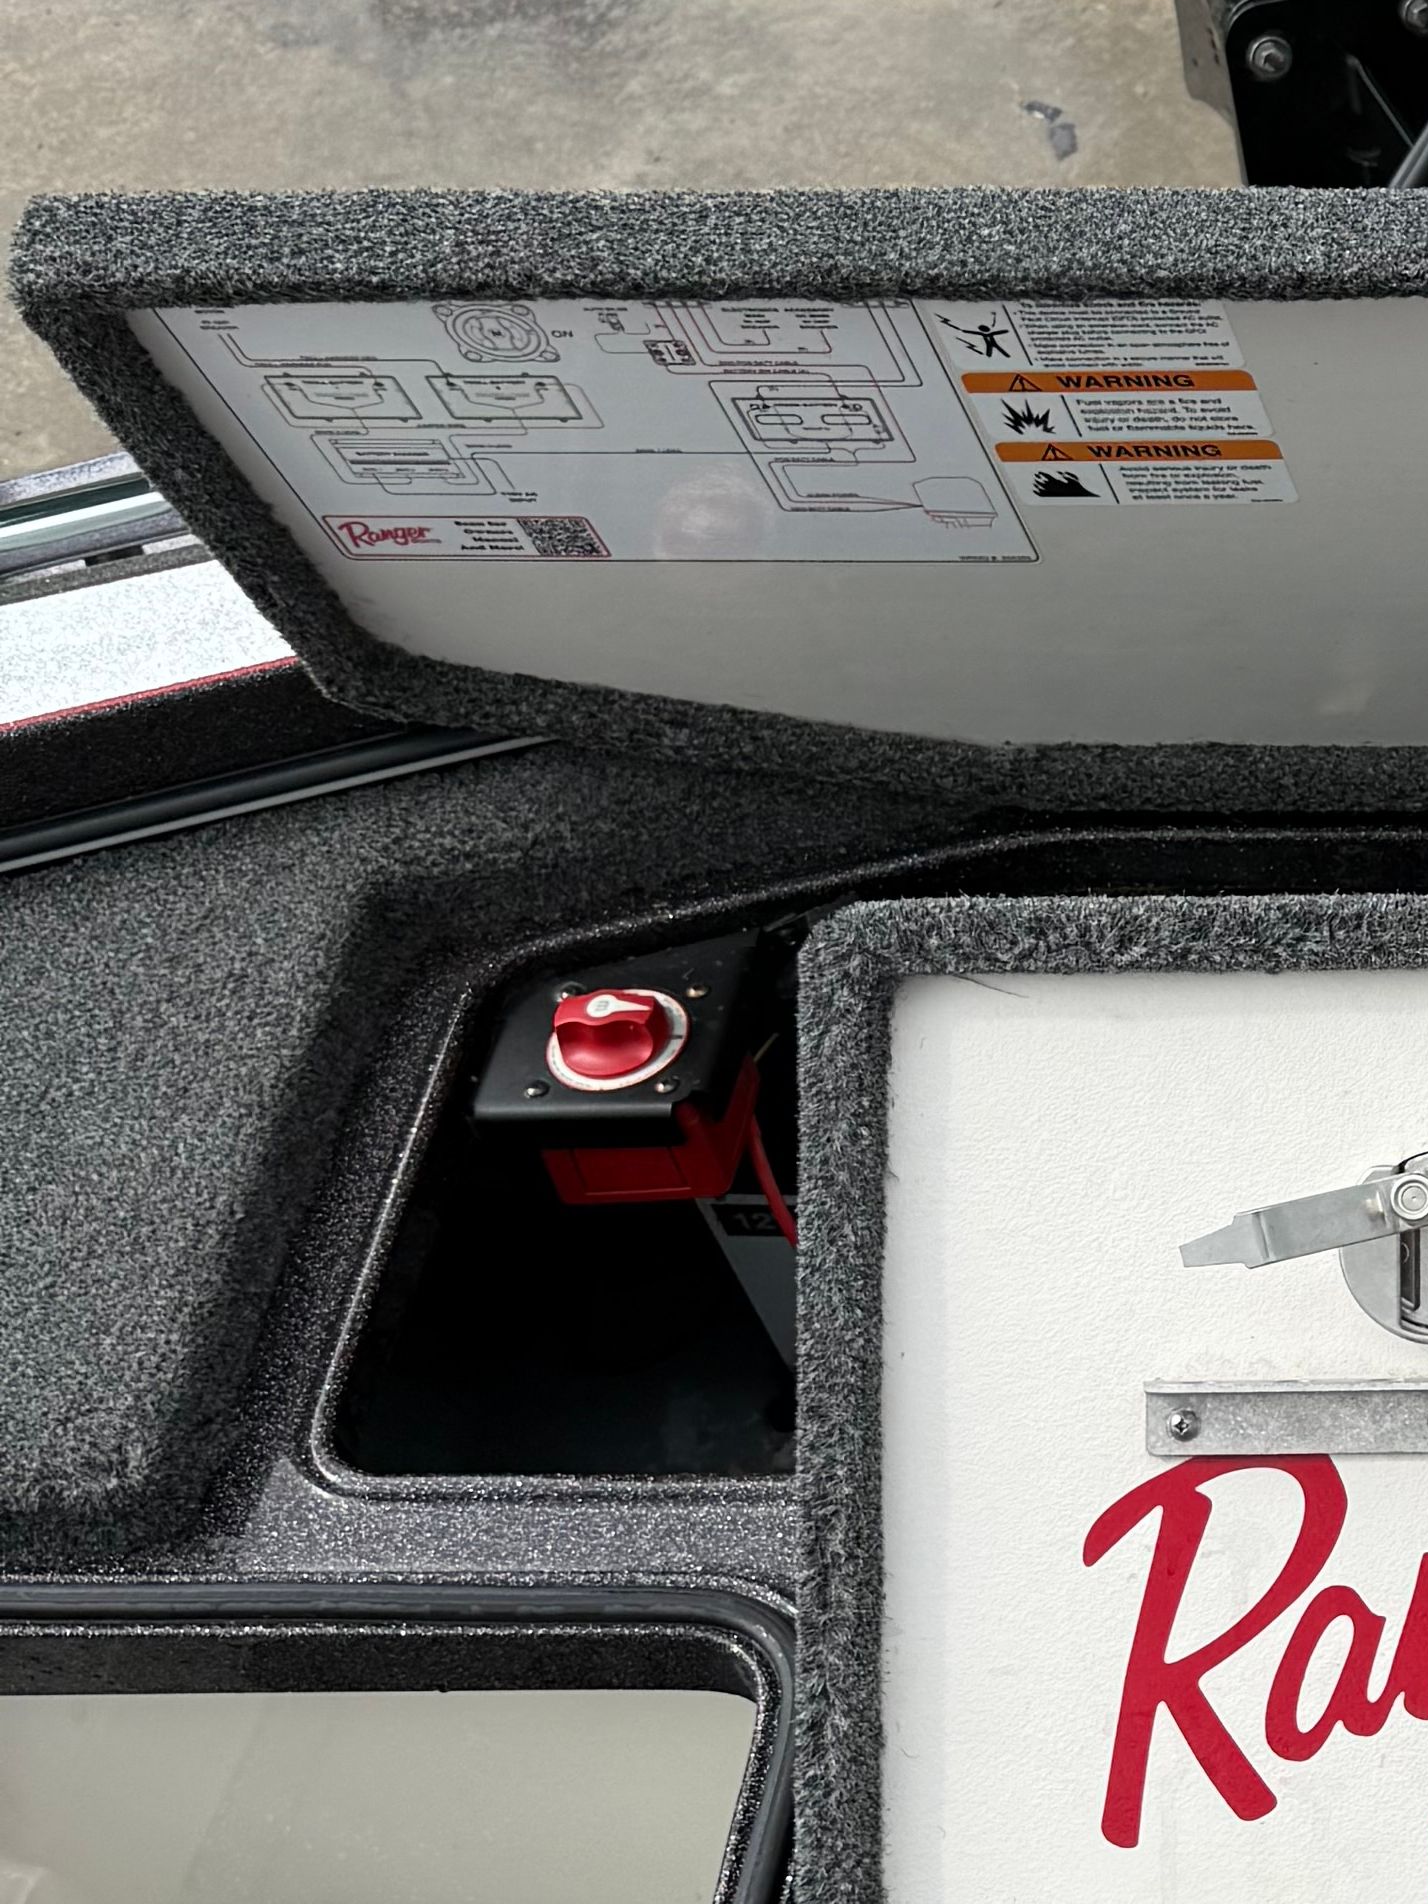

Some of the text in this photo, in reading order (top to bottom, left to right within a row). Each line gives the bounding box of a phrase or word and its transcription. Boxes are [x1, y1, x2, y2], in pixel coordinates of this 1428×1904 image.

[1056, 374, 1195, 389] WARNING
[1087, 444, 1223, 458] WARNING
[337, 521, 434, 549] Ranger
